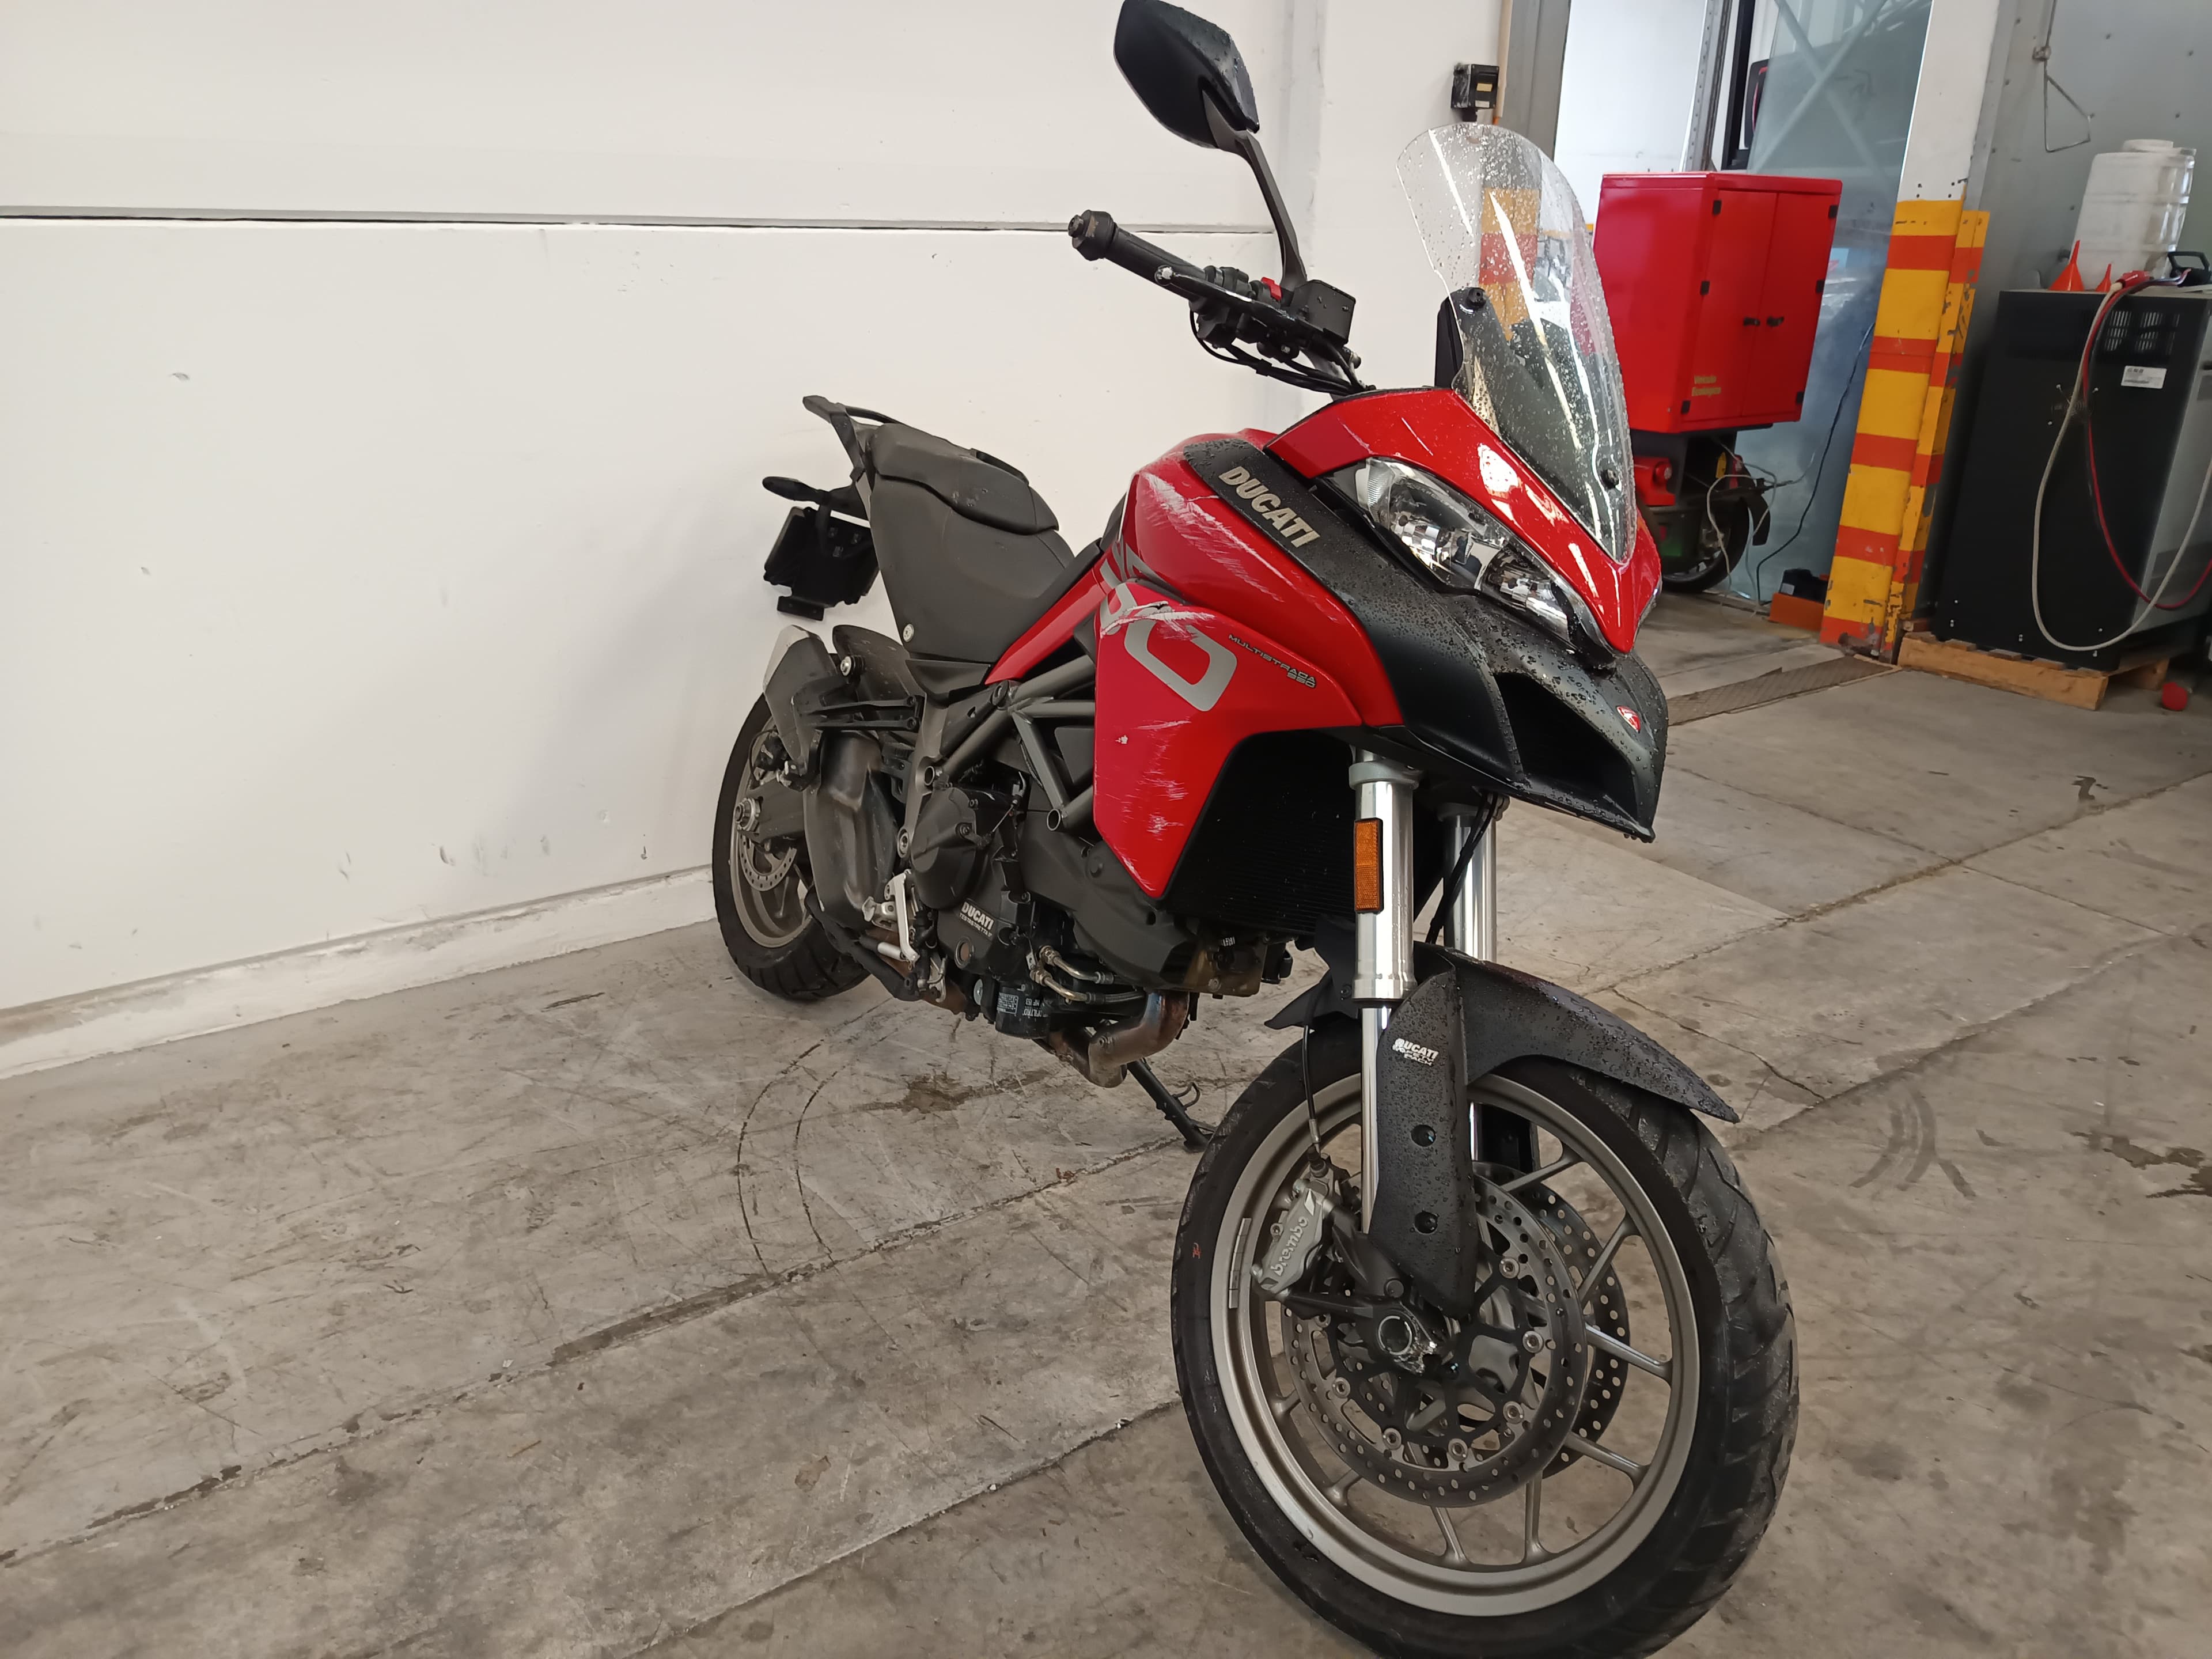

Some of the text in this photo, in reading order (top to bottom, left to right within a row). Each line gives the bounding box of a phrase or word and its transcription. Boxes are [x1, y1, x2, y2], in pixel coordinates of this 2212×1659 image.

[1218, 465, 1320, 548] DUCATI
[1228, 634, 1316, 683] MULTISTRADA
[1286, 672, 1316, 688] 950
[961, 901, 994, 930] DUCATI
[1270, 1216, 1308, 1277] brembo
